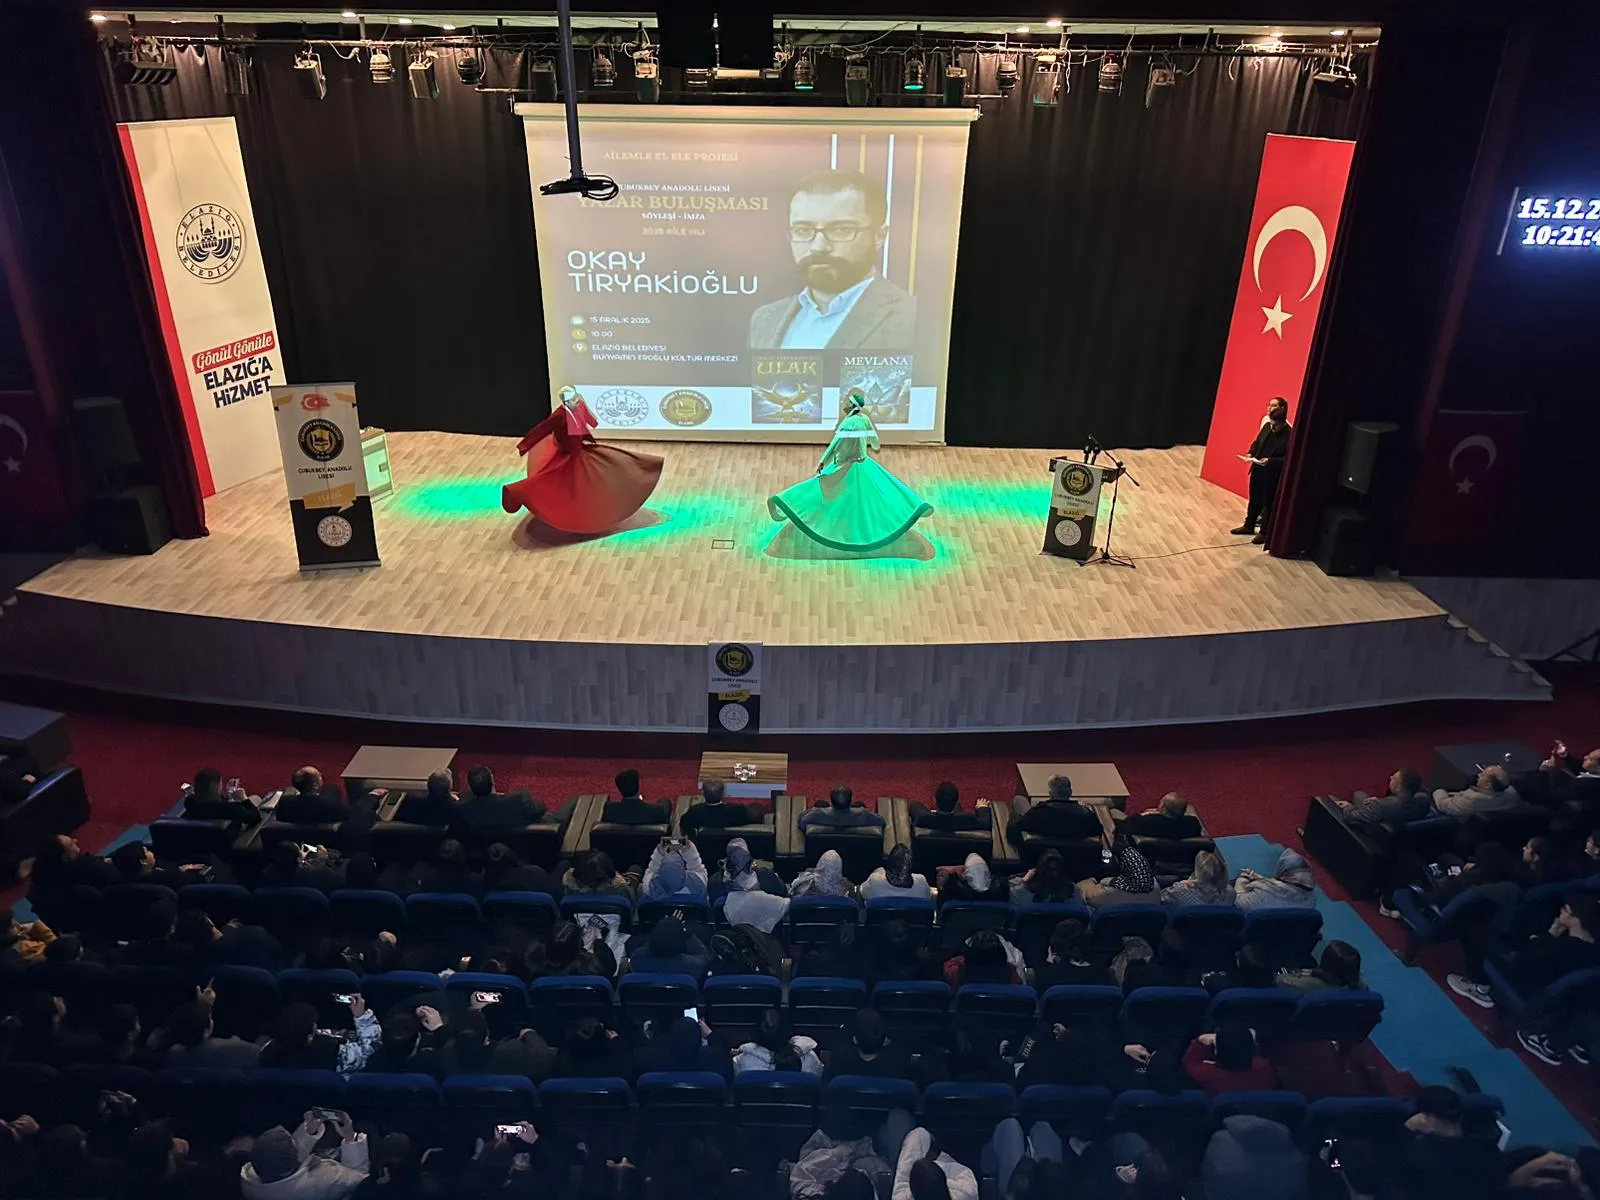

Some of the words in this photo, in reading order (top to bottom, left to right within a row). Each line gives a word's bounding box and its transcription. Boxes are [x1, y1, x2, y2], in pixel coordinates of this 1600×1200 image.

[654, 152, 668, 160] EL
[694, 152, 738, 162] PROJESİ
[648, 195, 769, 212] BULUŞMASI
[567, 250, 646, 270] OKAY
[567, 269, 758, 294] TİRYAKİOĞLU
[196, 345, 233, 370] Gönül
[233, 333, 273, 359] Gönüle
[756, 361, 817, 375] ULAK
[844, 357, 908, 366] MEVLANA
[203, 356, 273, 390] ELAZIĞ'A
